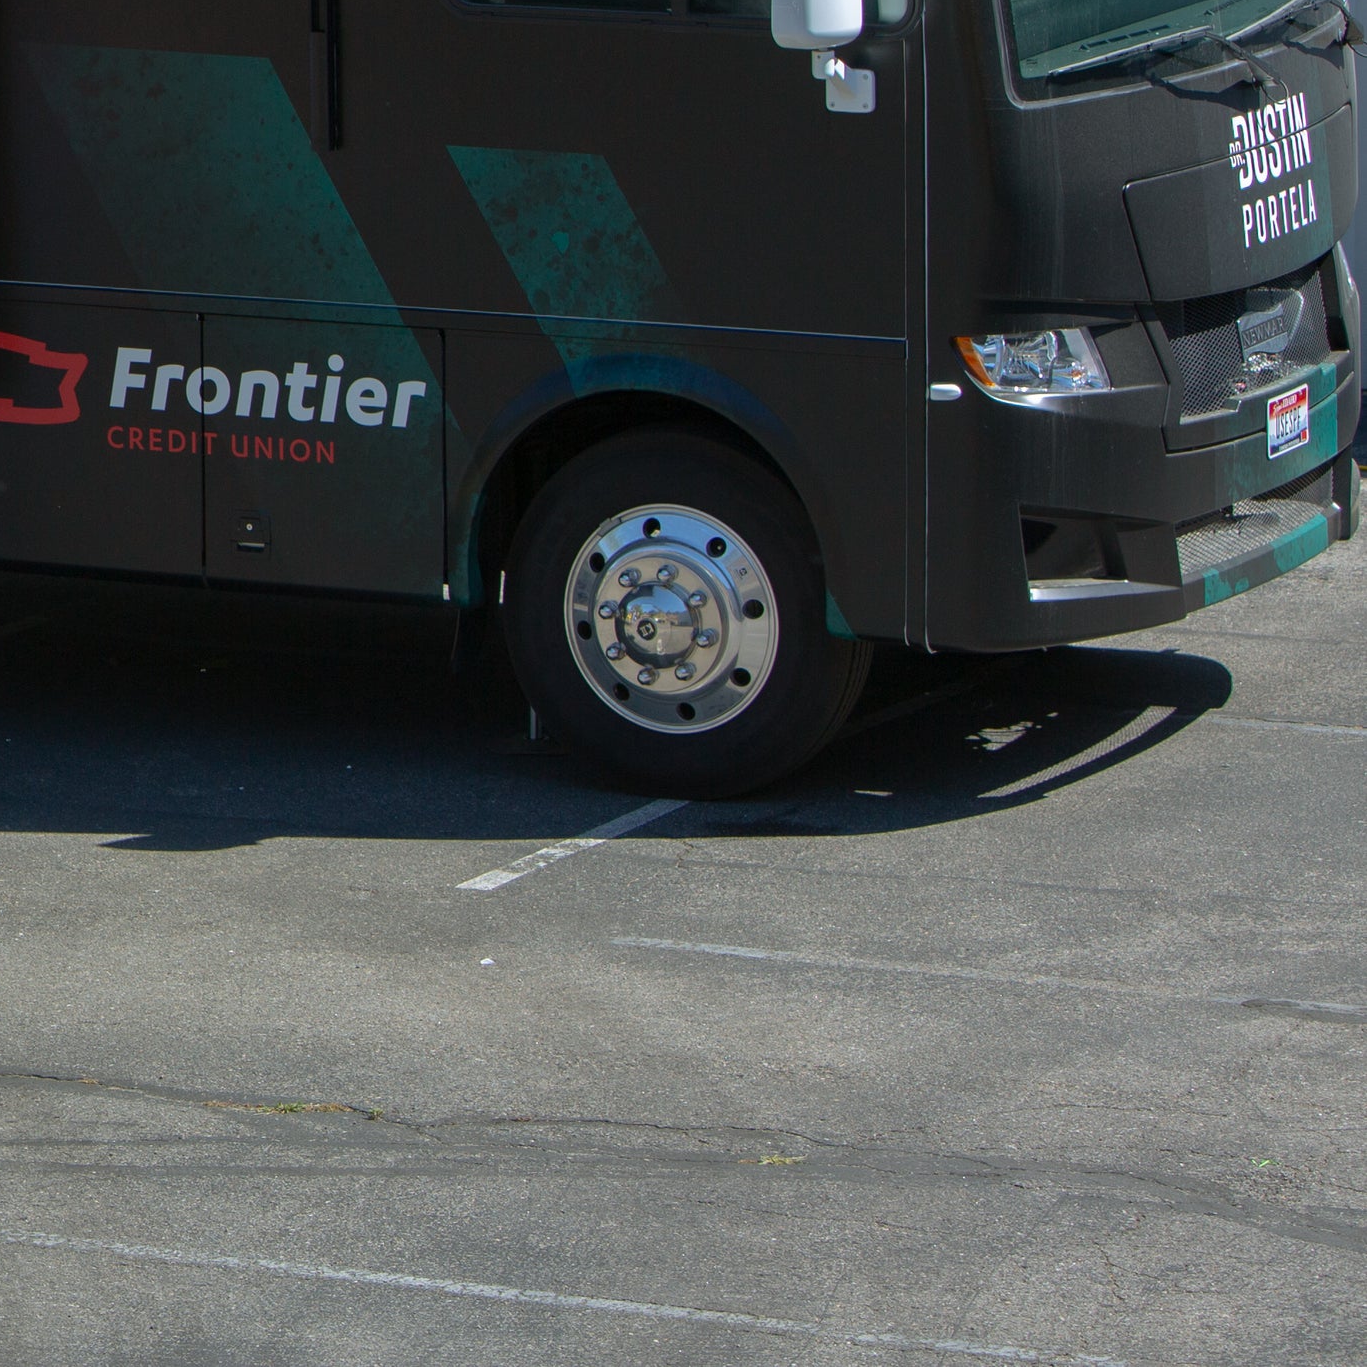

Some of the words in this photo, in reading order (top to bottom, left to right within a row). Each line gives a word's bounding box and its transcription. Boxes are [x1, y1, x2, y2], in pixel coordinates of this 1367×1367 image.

[1231, 92, 1312, 190] DUSTIN
[1242, 179, 1317, 248] PORTELA
[1242, 317, 1286, 348] NEWMAR
[109, 346, 427, 429] Frontier
[106, 425, 218, 456] CREDIT
[231, 435, 335, 465] UNION
[1276, 405, 1301, 439] USESPF
